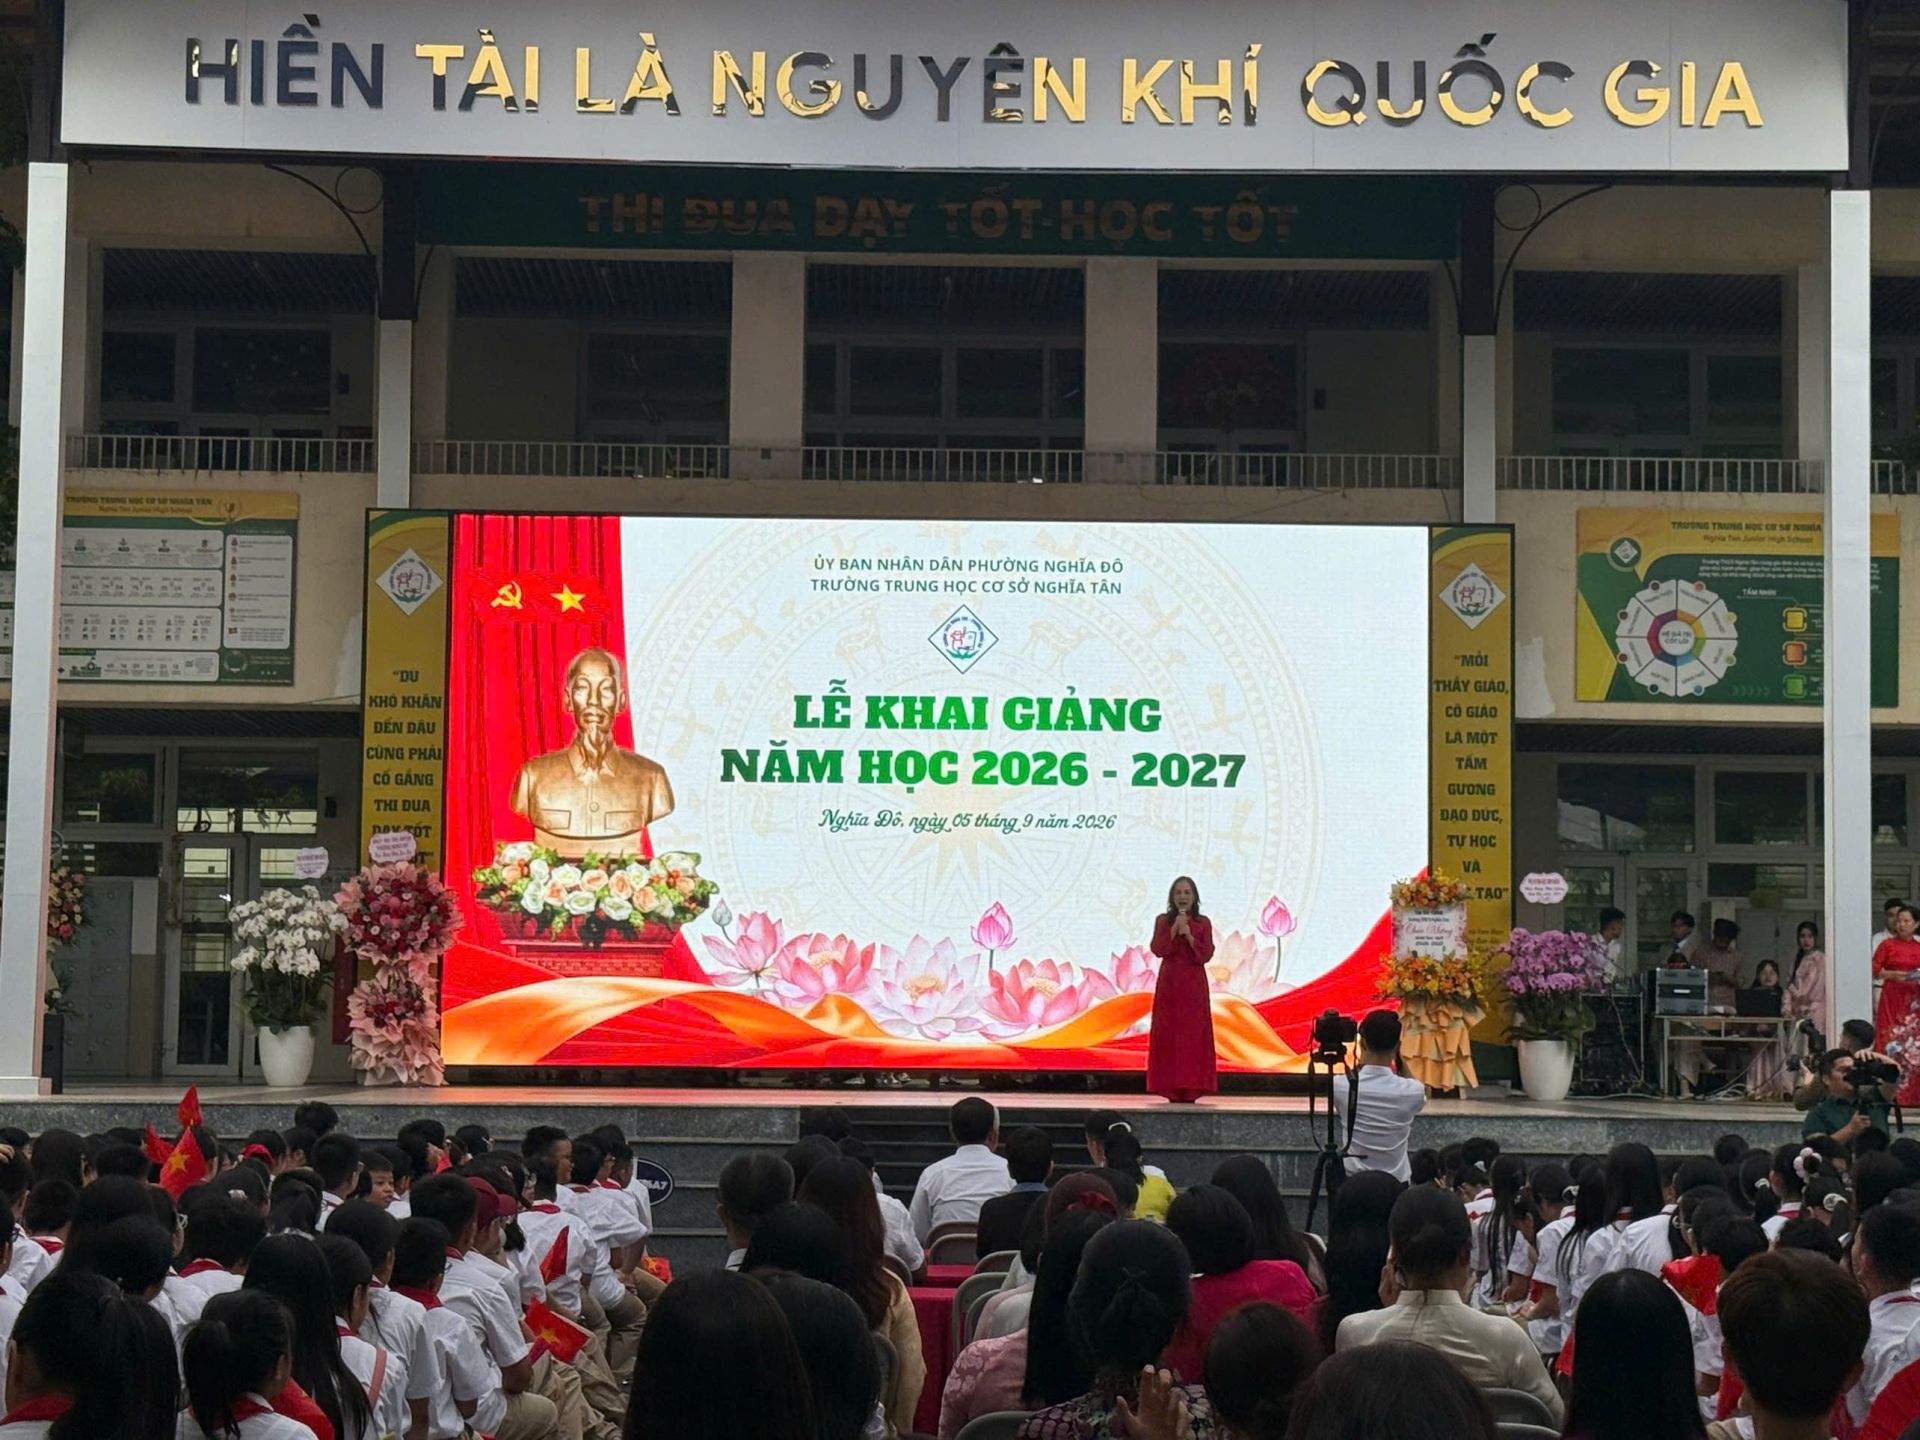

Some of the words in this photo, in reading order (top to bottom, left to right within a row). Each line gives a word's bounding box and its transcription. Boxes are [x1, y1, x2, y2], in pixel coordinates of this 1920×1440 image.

[185, 13, 385, 109] HIỀN
[415, 28, 540, 114] TÀI
[576, 32, 681, 116] LÀ
[711, 43, 1085, 125] NGUYÊN
[1122, 43, 1262, 127] KHÍ
[1301, 32, 1575, 129] QUỐC
[1604, 60, 1764, 128] GIA
[578, 195, 664, 237] THI
[681, 196, 796, 240] ĐUA
[813, 195, 915, 250] DẠY
[1193, 189, 1300, 245] TỐT
[814, 554, 835, 571] ỦY
[840, 558, 872, 571] BAN
[878, 556, 924, 571] NHÂN
[930, 556, 963, 572] DÂN
[968, 556, 1039, 573] PHƯỜNG
[1044, 557, 1096, 573] NGHĨA
[1101, 558, 1124, 573] ĐÔ
[811, 576, 880, 592] TRƯỜNG
[885, 580, 938, 593] TRUNG
[943, 580, 977, 596] HỌC
[982, 580, 1005, 593] CƠ
[1008, 577, 1030, 593] SỞ
[1034, 579, 1086, 594] NGHĨA
[1090, 579, 1122, 594] TÂN
[793, 679, 852, 730] LỄ
[865, 694, 989, 731] KHAI
[1002, 685, 1162, 733] GIẢNG
[1466, 703, 1498, 718] GIÁO
[719, 741, 844, 785] NĂM
[858, 749, 959, 794] HỌC
[972, 751, 1089, 787] 2026
[1102, 770, 1117, 778] -
[1131, 752, 1247, 788] 2027
[374, 799, 398, 812] THI
[818, 809, 870, 833] Nghĩa
[909, 812, 952, 833] ngày
[952, 813, 971, 828] 05
[975, 812, 1022, 834] tháng
[1022, 814, 1033, 828] 9
[1035, 813, 1070, 829] năm
[1072, 814, 1118, 829] 2026
[1440, 808, 1468, 824] ĐẠO
[1469, 835, 1497, 851] HỌC
[1462, 858, 1481, 874] VÀ
